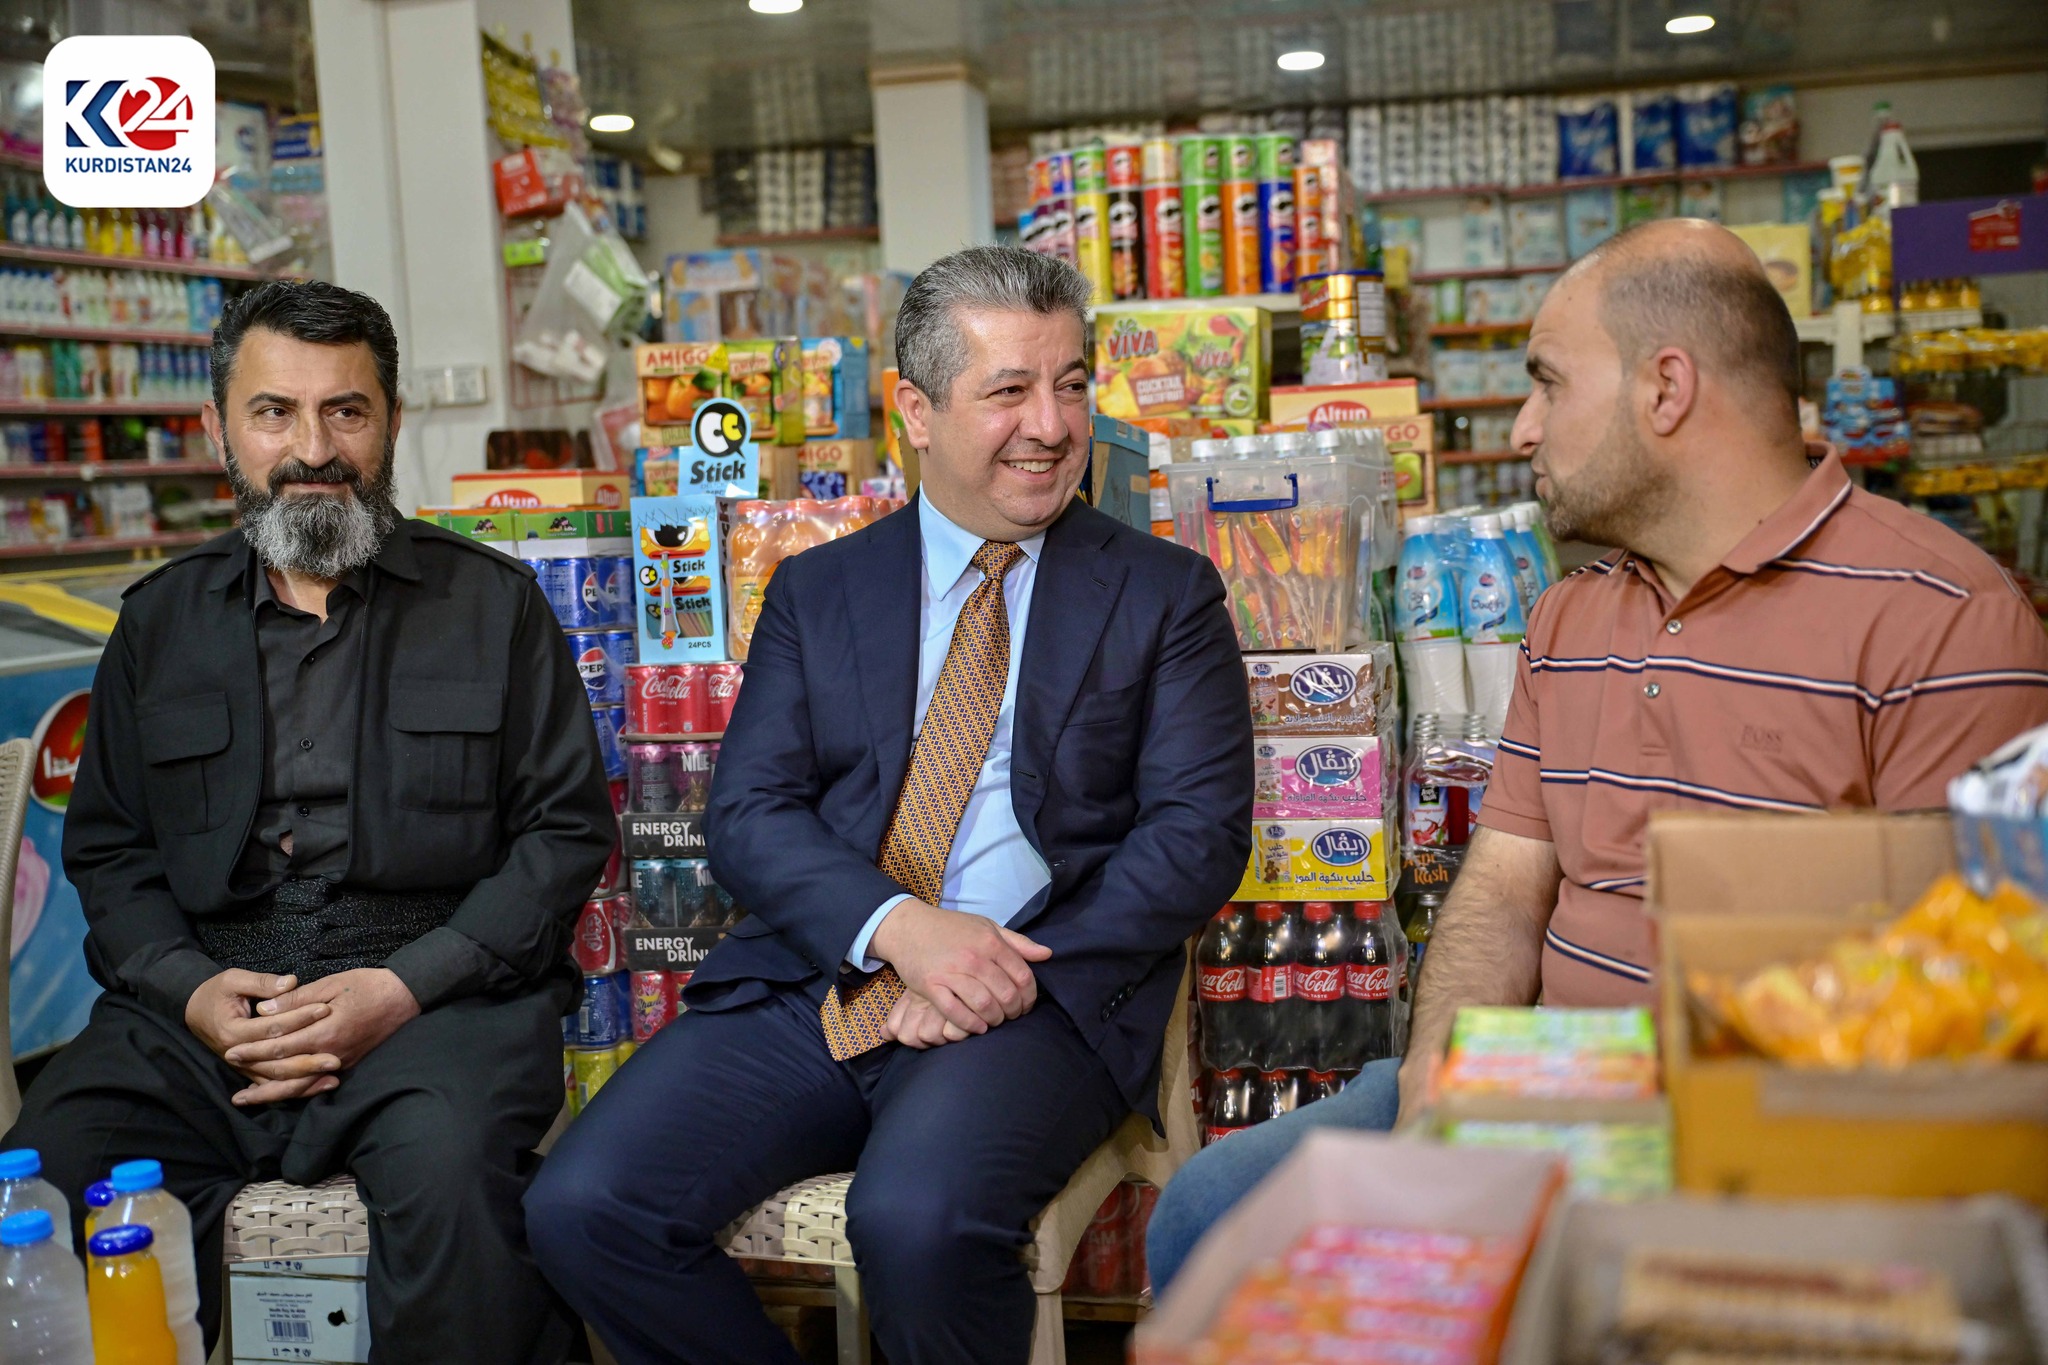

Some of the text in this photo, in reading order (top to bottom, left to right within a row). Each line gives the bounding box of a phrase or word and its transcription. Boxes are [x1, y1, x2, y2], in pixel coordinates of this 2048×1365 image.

[1108, 330, 1159, 361] VIVA
[690, 460, 746, 485] Stick
[673, 560, 705, 573] Stick
[675, 597, 711, 612] Stick
[688, 641, 712, 649] 24PCS
[632, 822, 691, 836] ENERGY
[1295, 870, 1375, 885] حليب بنكهة الموز
[635, 937, 694, 950] ENERGY
